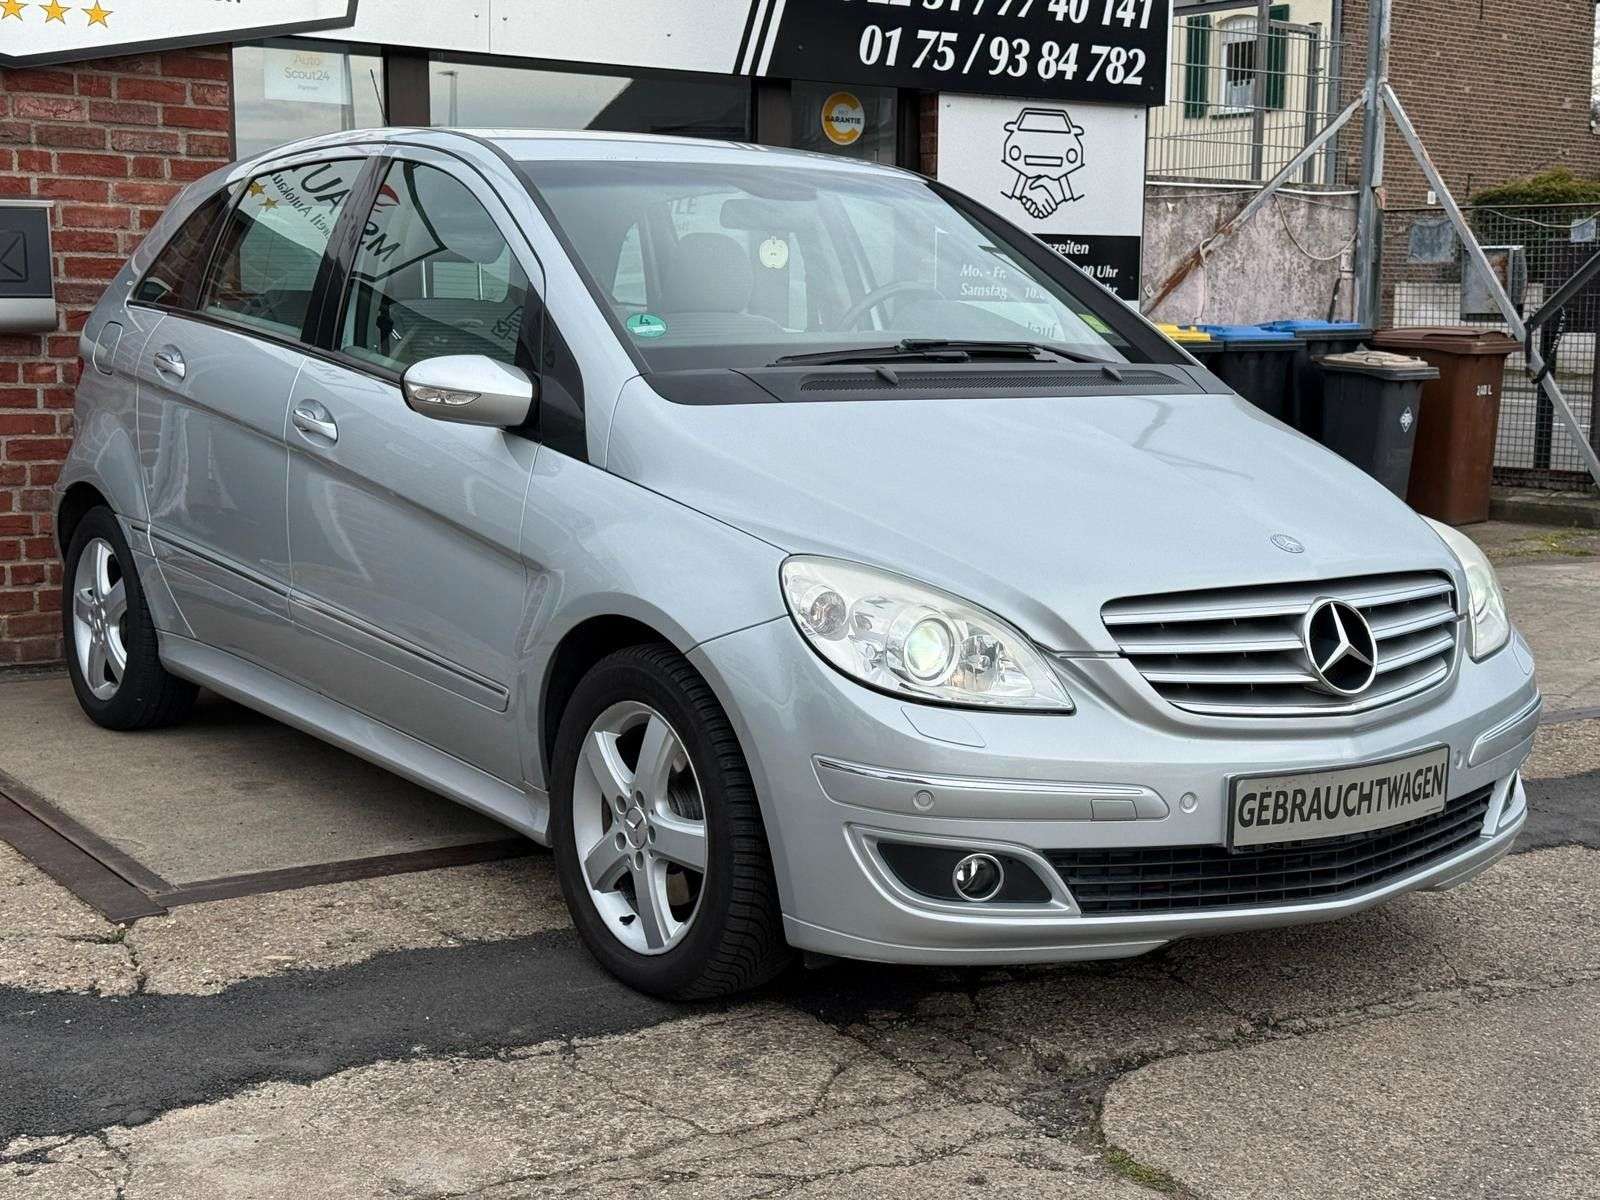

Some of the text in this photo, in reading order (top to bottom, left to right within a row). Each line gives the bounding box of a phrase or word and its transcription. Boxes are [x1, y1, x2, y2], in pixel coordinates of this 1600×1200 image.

[1101, 0, 1153, 29] 141
[859, 24, 1147, 86] 01 75 / 93 84 782
[824, 115, 862, 125] GARANTIE
[1096, 265, 1119, 278] Uhr
[960, 282, 1008, 301] Samstag
[1237, 763, 1446, 829] GEBRAUCHTWAGEN
